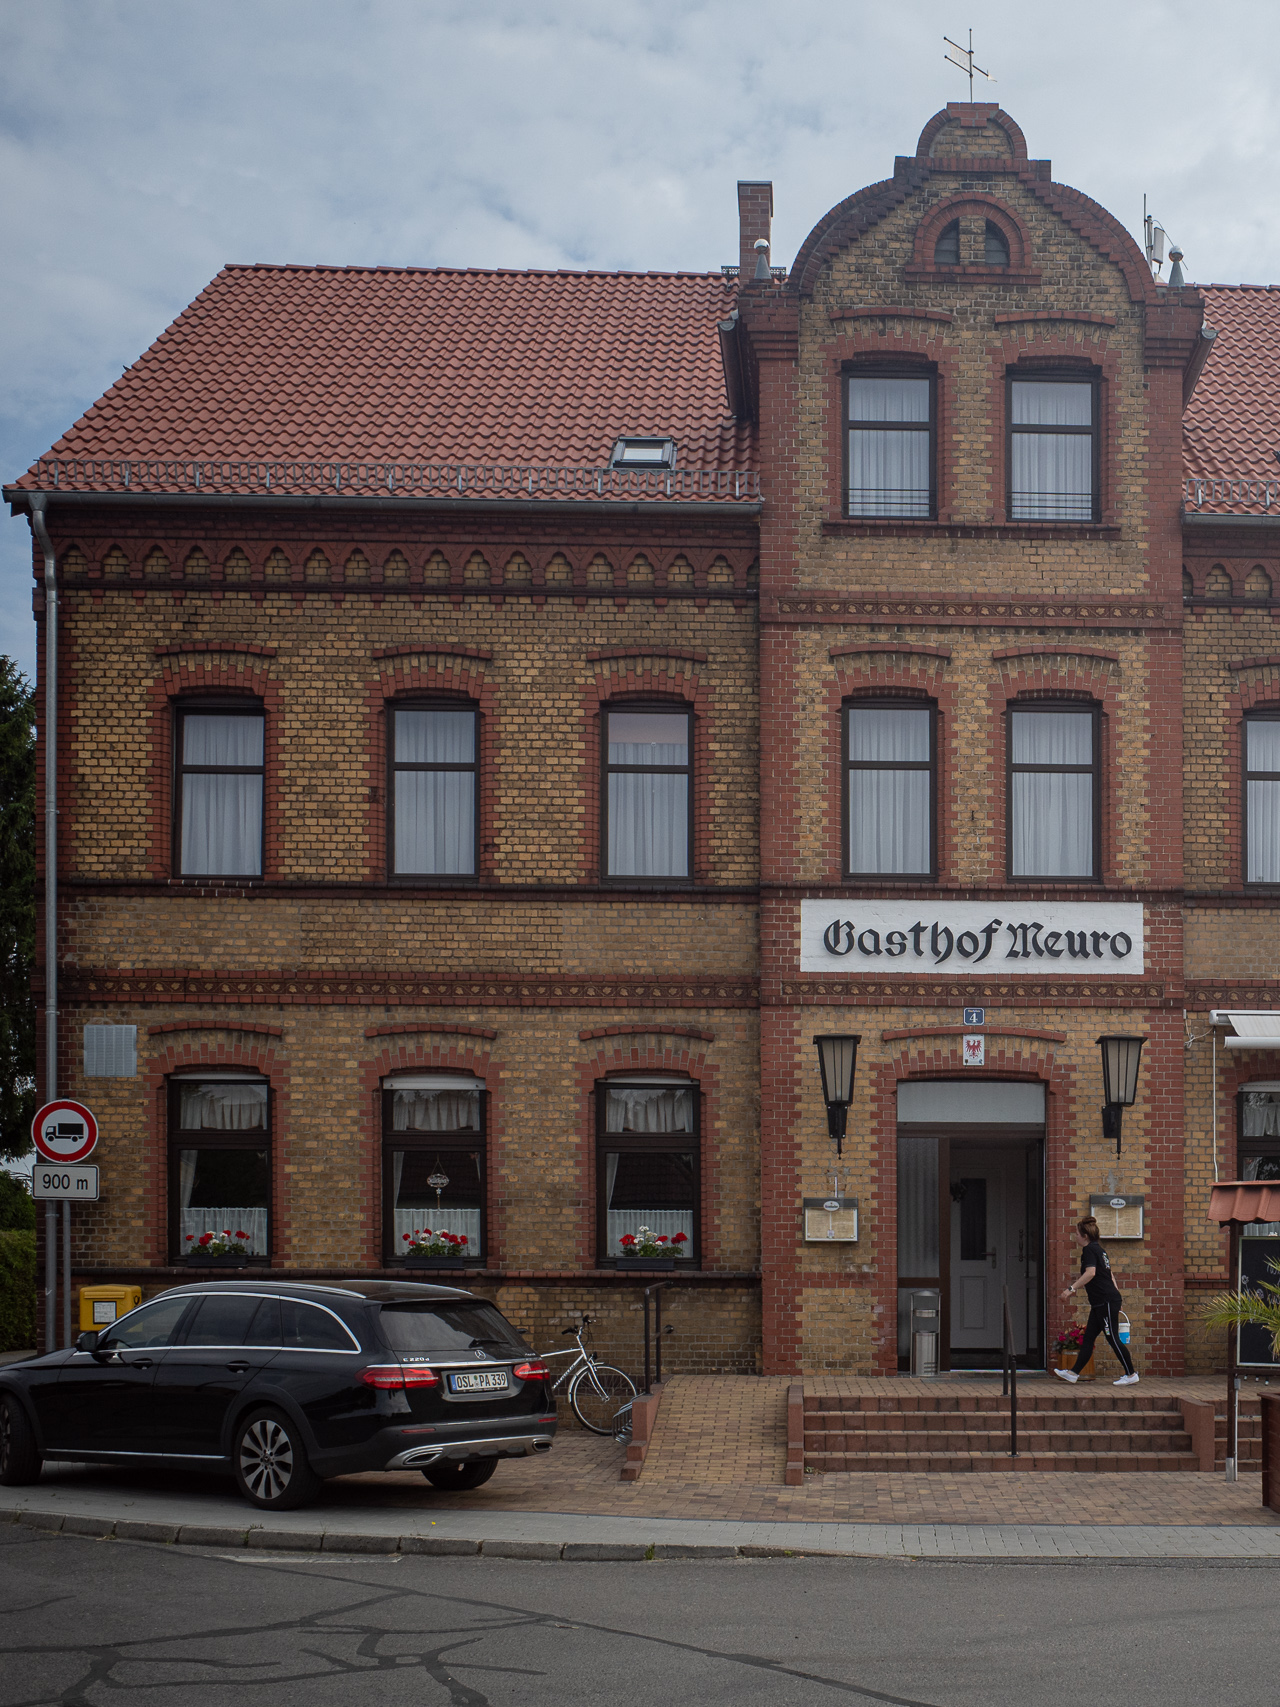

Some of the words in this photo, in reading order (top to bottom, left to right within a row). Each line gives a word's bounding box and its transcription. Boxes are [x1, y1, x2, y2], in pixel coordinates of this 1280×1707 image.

[823, 918, 1002, 965] Gasthof
[1005, 921, 1132, 959] Meuro
[969, 1012, 979, 1023] 4
[42, 1173, 71, 1190] 900
[76, 1178, 89, 1190] m
[456, 1375, 474, 1389] OSL
[479, 1374, 491, 1387] PA
[490, 1373, 506, 1386] 339
